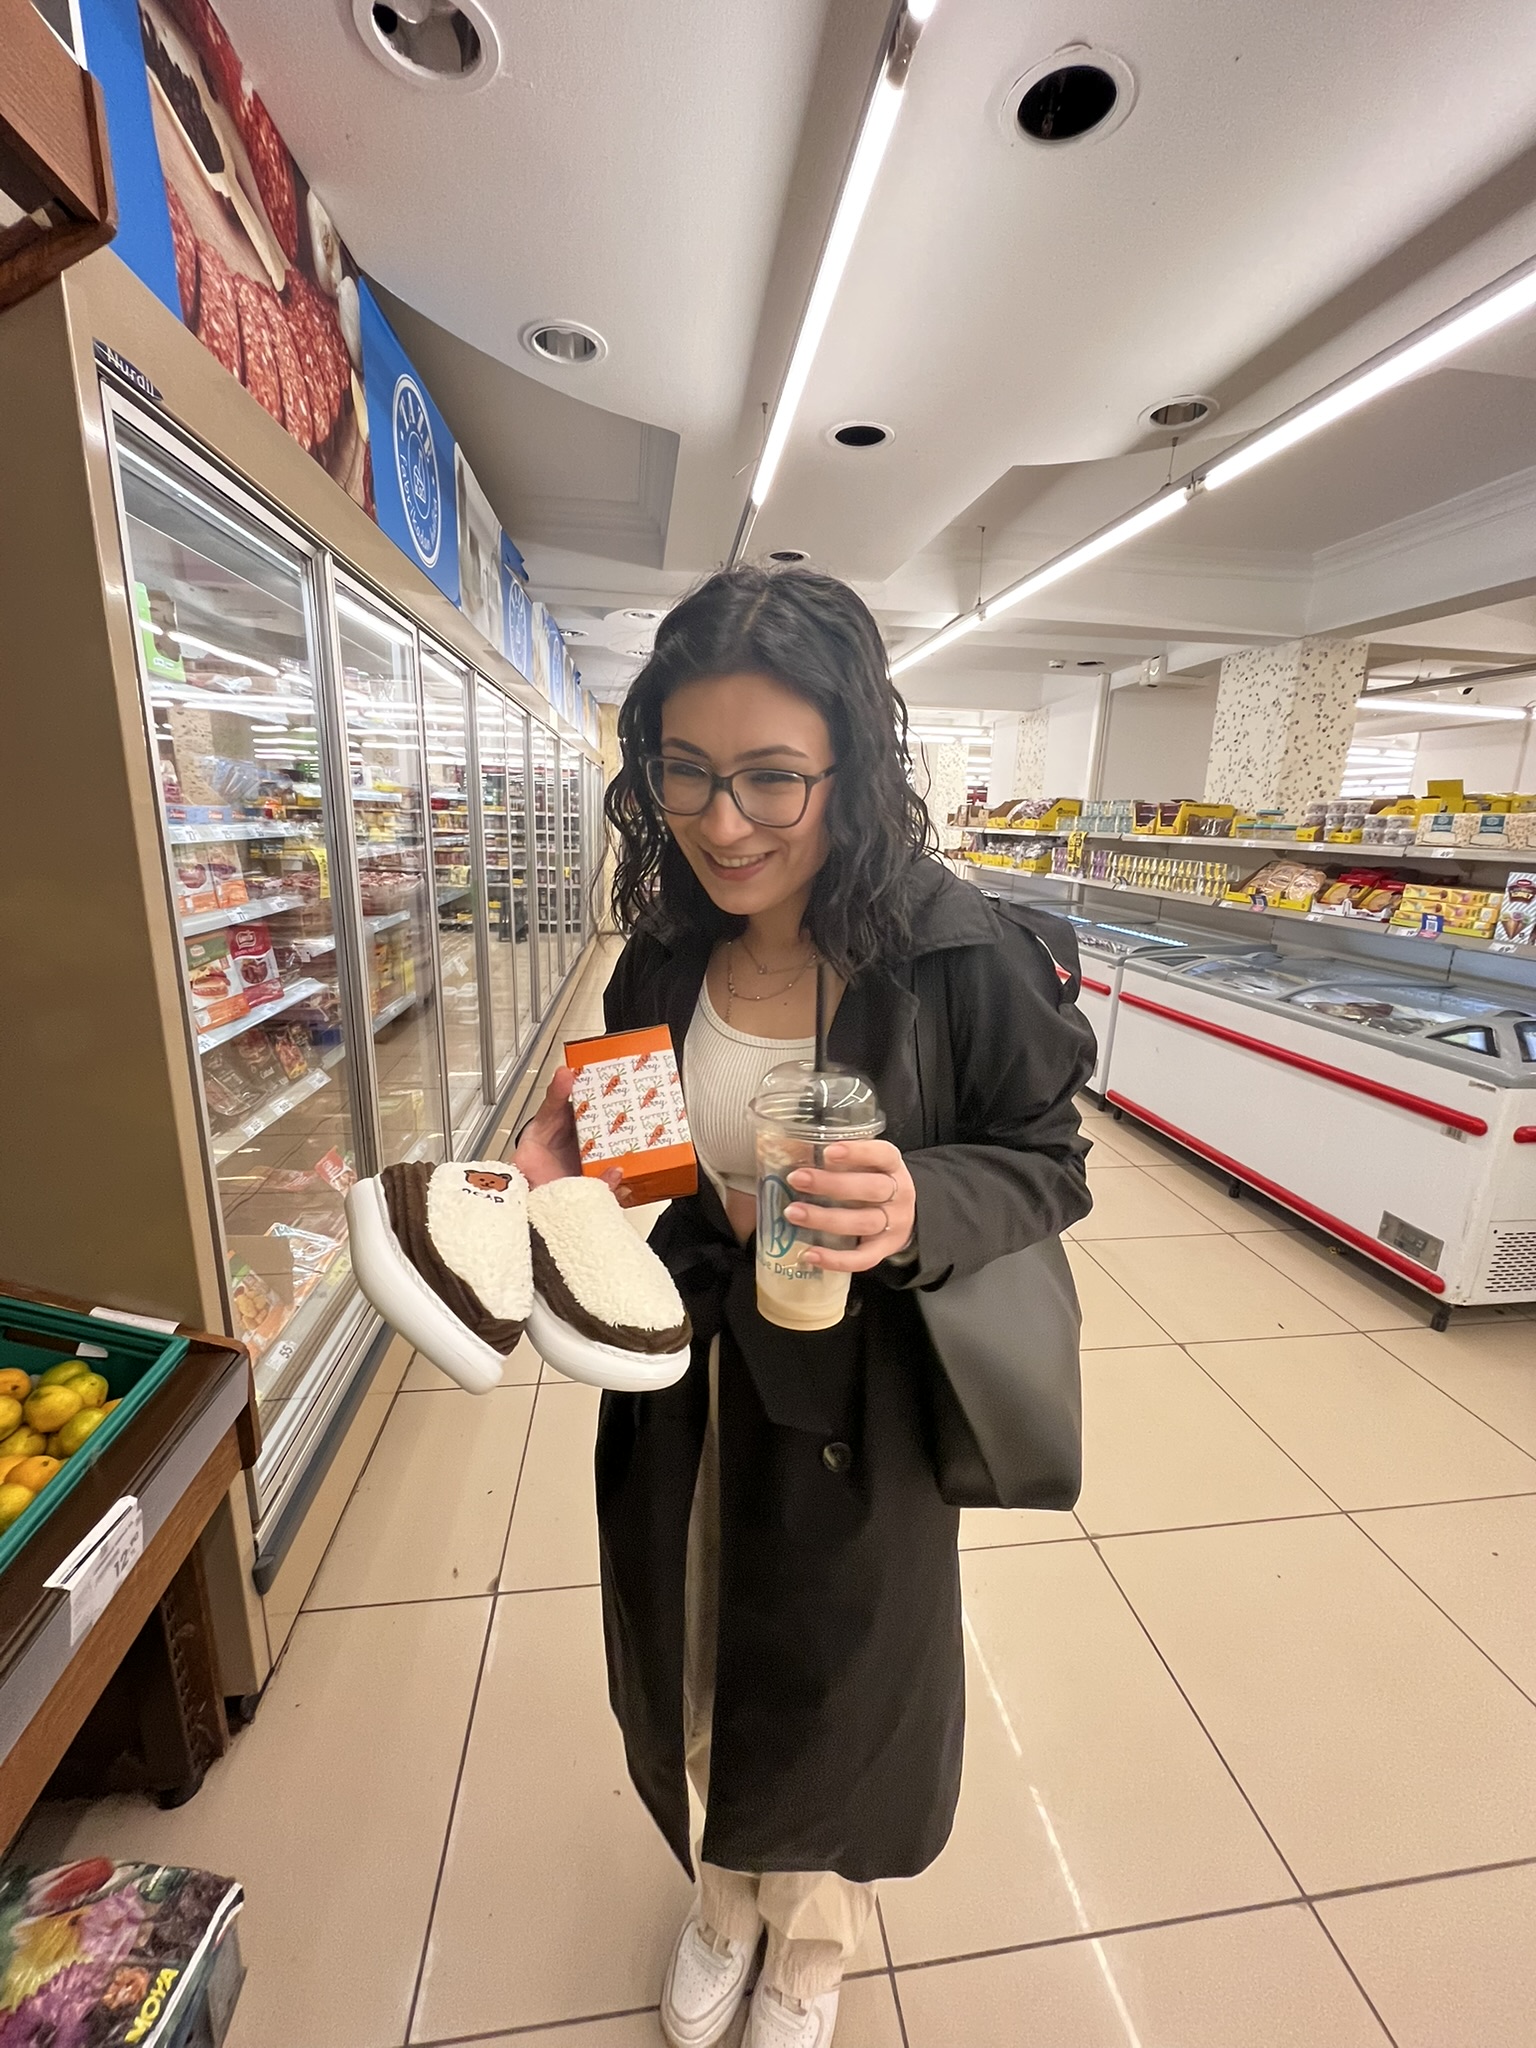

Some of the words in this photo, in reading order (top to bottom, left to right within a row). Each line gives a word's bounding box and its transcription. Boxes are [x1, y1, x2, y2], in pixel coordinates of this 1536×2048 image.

[106, 347, 155, 397] Nurdil
[278, 1345, 294, 1359] 55
[124, 1967, 180, 2045] MOYA
